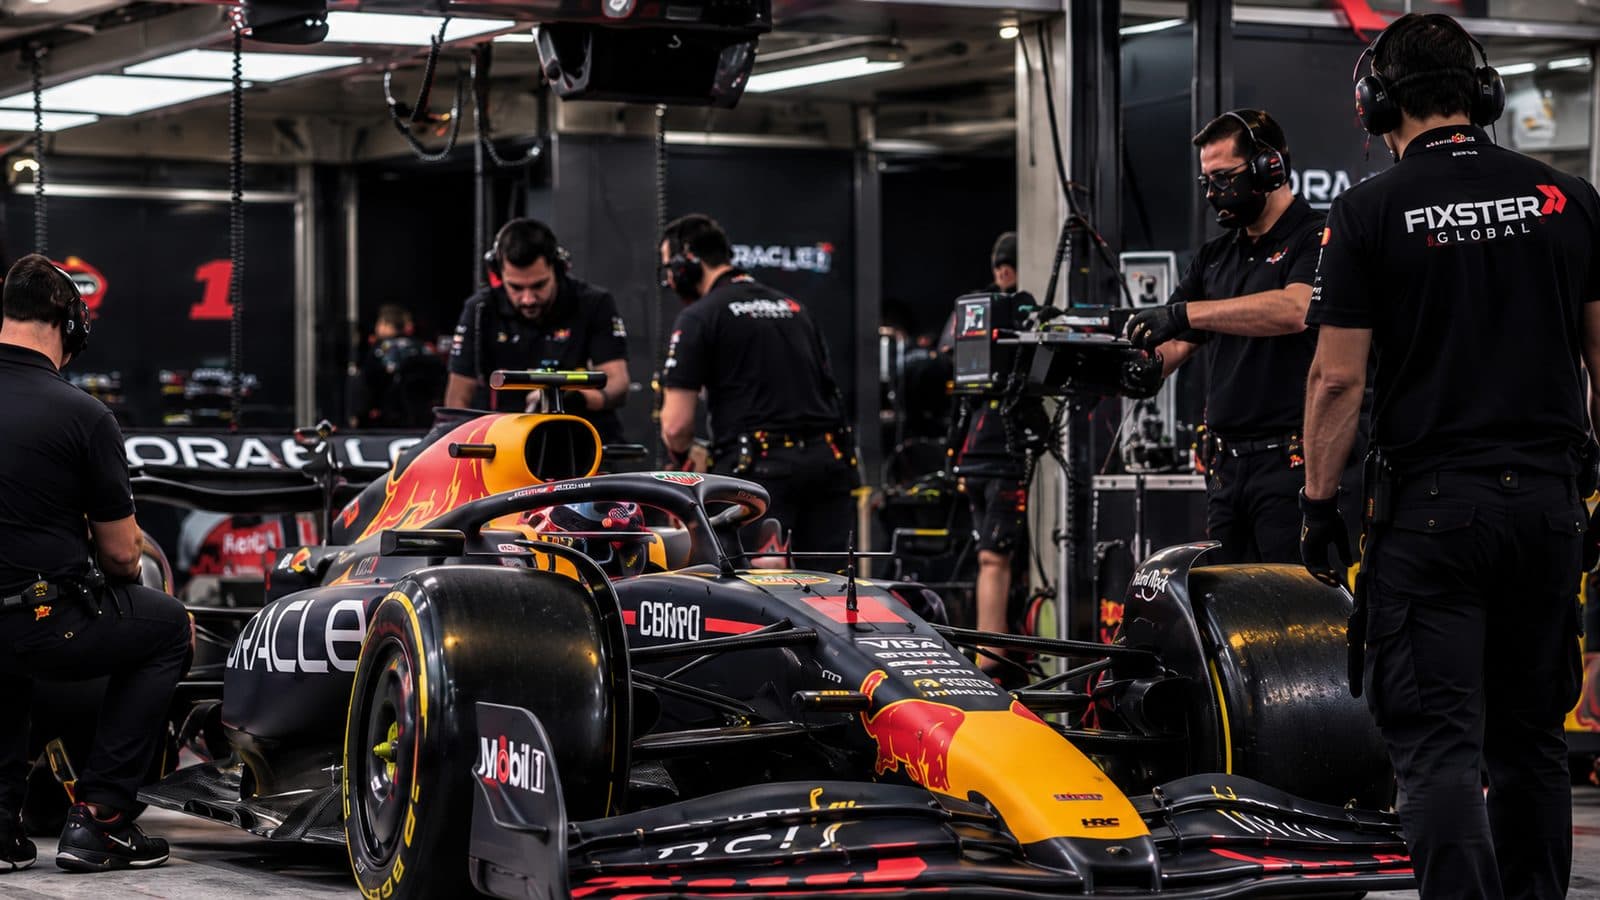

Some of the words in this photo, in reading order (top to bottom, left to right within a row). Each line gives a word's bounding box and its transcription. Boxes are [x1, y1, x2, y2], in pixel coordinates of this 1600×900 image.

[1404, 196, 1542, 233] FIXSTER
[1437, 223, 1530, 244] GLOBAL
[730, 244, 815, 271] RACLE
[189, 259, 234, 320] 1
[857, 640, 943, 649] VISA
[477, 735, 530, 790] Mobil
